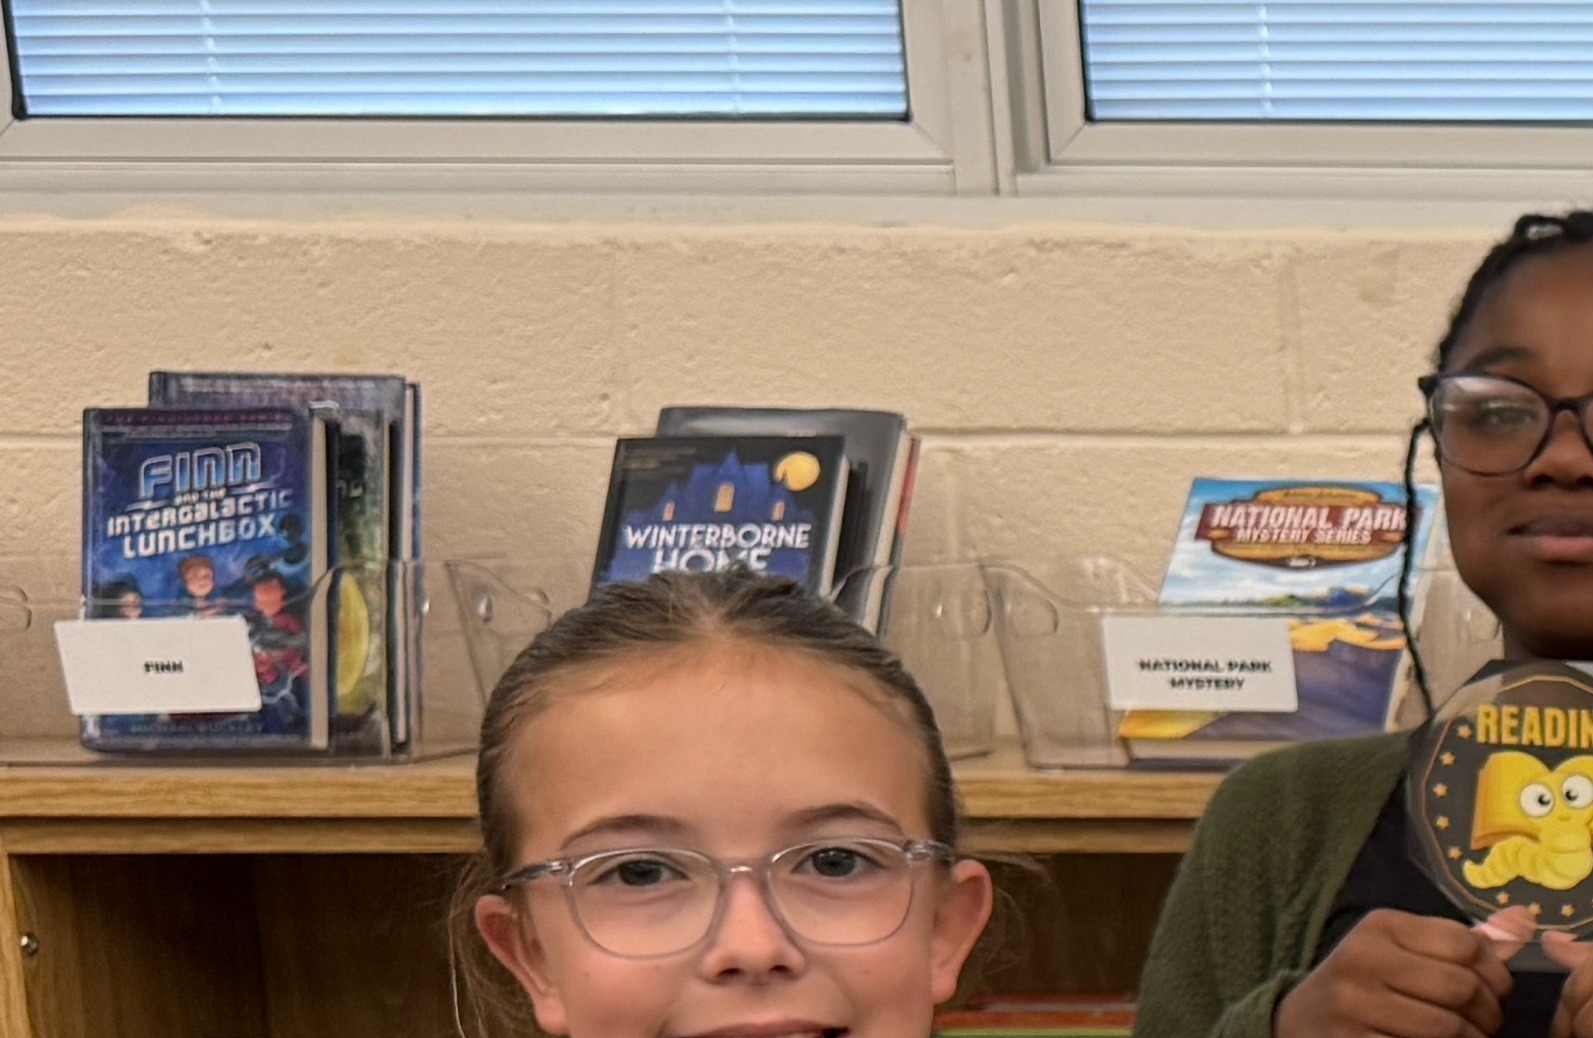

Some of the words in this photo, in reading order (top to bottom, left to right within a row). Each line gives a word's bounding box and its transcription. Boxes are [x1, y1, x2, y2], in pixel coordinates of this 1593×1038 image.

[1211, 505, 1333, 529] NATIONAL
[123, 513, 276, 559] LUNCHBOX
[626, 522, 811, 549] WINTERBORNE
[1236, 528, 1311, 544] MYSTERY
[1314, 528, 1372, 545] SERIES
[144, 660, 184, 673] FINN
[1139, 659, 1224, 673] NATIONAL
[1227, 659, 1272, 673] PARK
[1170, 678, 1245, 690] MYSTERY
